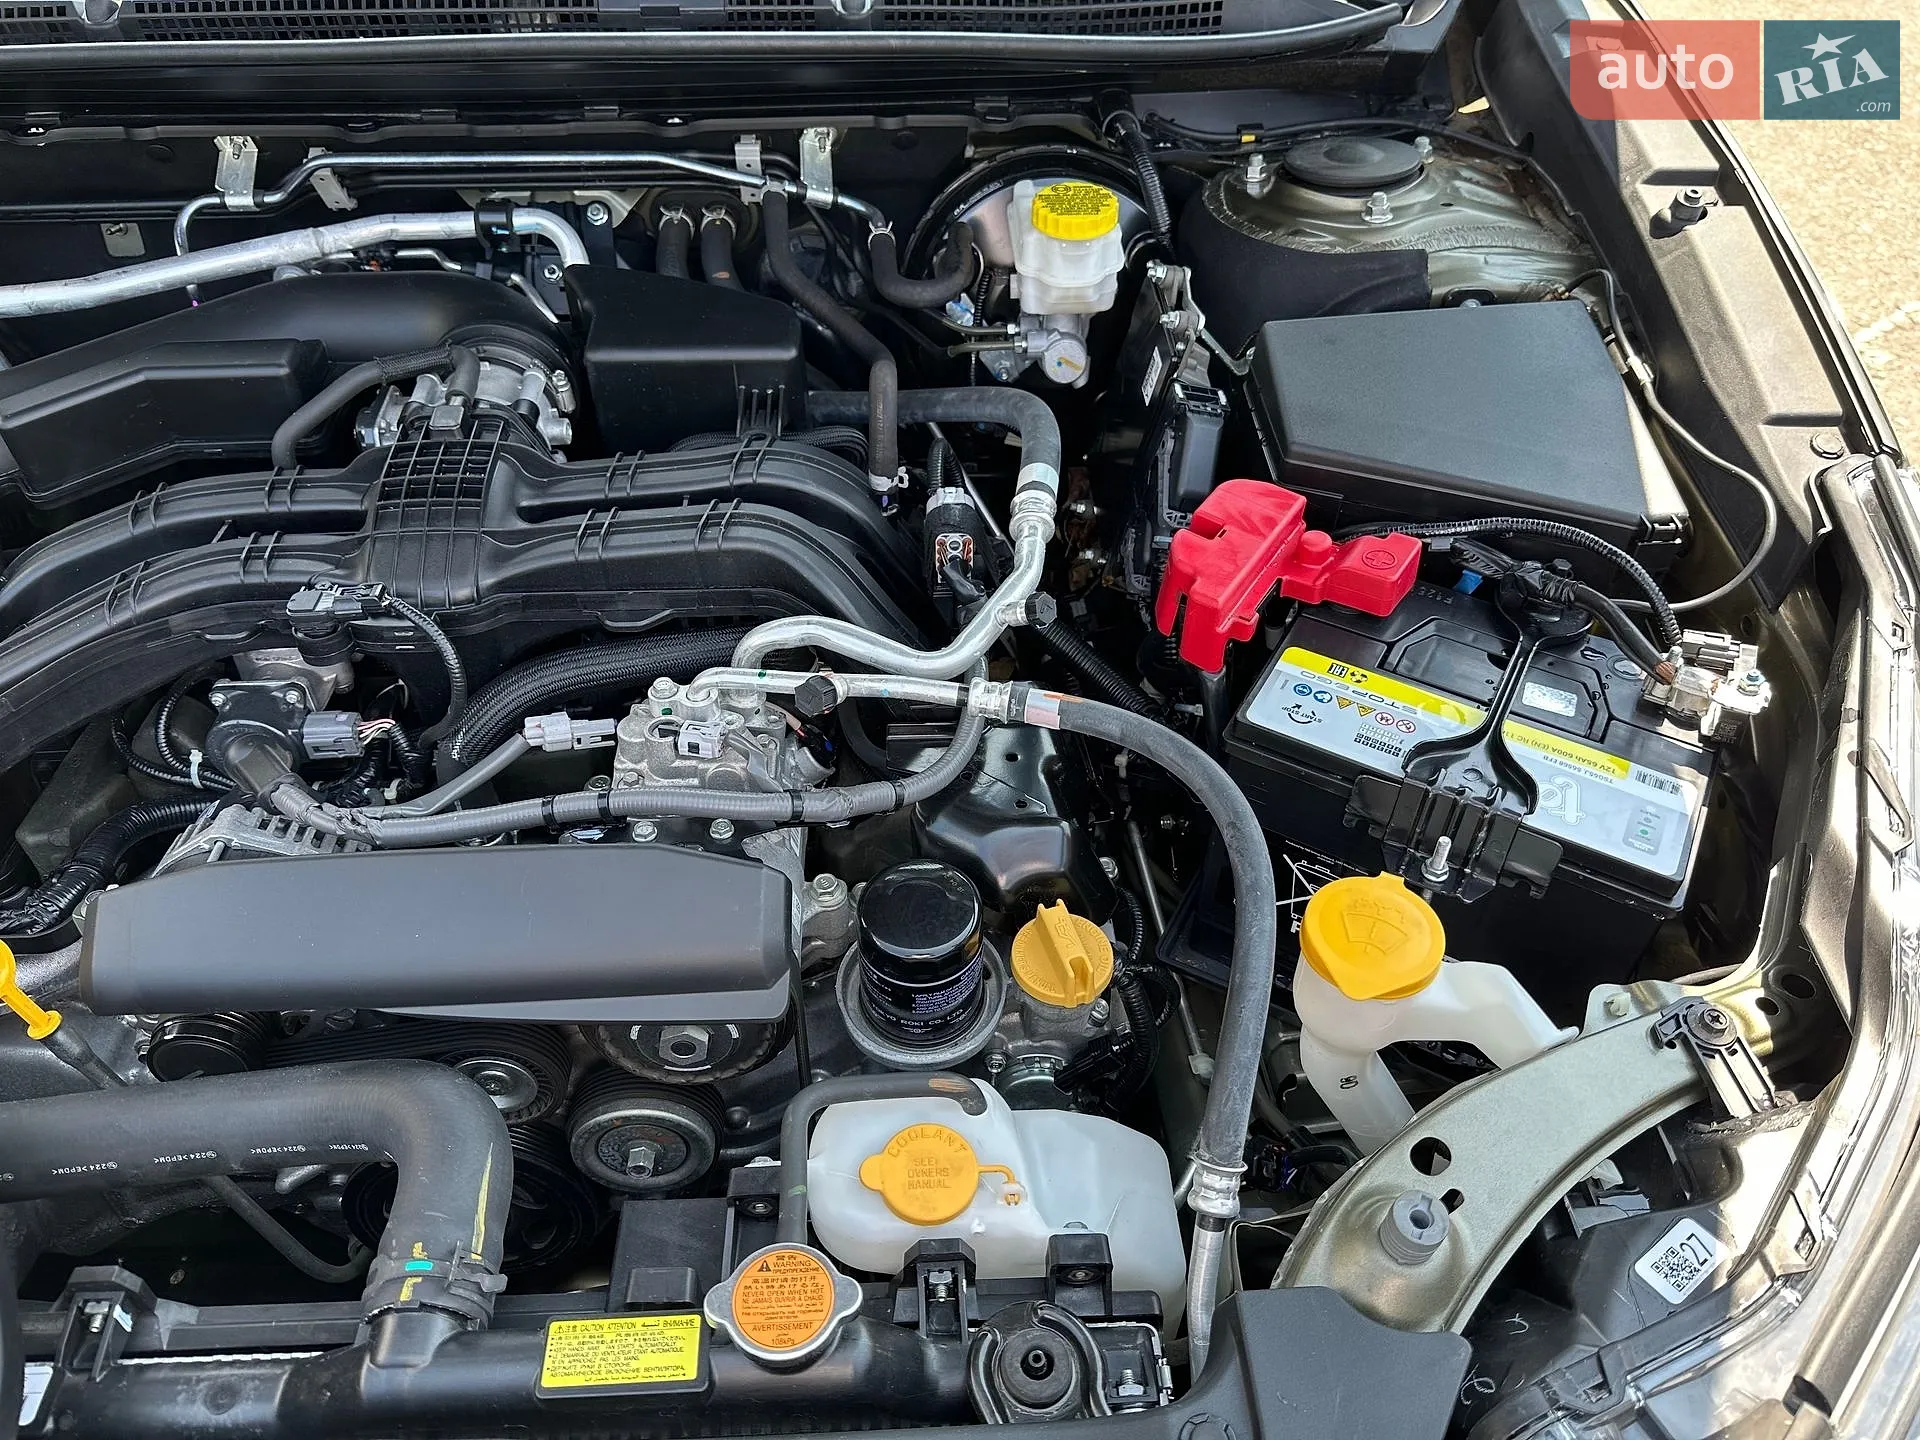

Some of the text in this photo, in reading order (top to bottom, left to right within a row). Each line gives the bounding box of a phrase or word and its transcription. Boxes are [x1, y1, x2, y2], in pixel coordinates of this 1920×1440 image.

[1599, 764, 1616, 774] 12V
[887, 1127, 968, 1158] COOLANT
[913, 1156, 937, 1166] SEE
[907, 1179, 951, 1190] MANUAL
[1679, 1232, 1713, 1267] 27
[773, 1260, 811, 1268] WARNING
[742, 1290, 764, 1298] NEVER
[787, 1288, 808, 1296] WHEN
[580, 1322, 604, 1332] CAUTION
[607, 1321, 637, 1331] ATTENTION
[751, 1322, 813, 1332] AVERTISSEMENT
